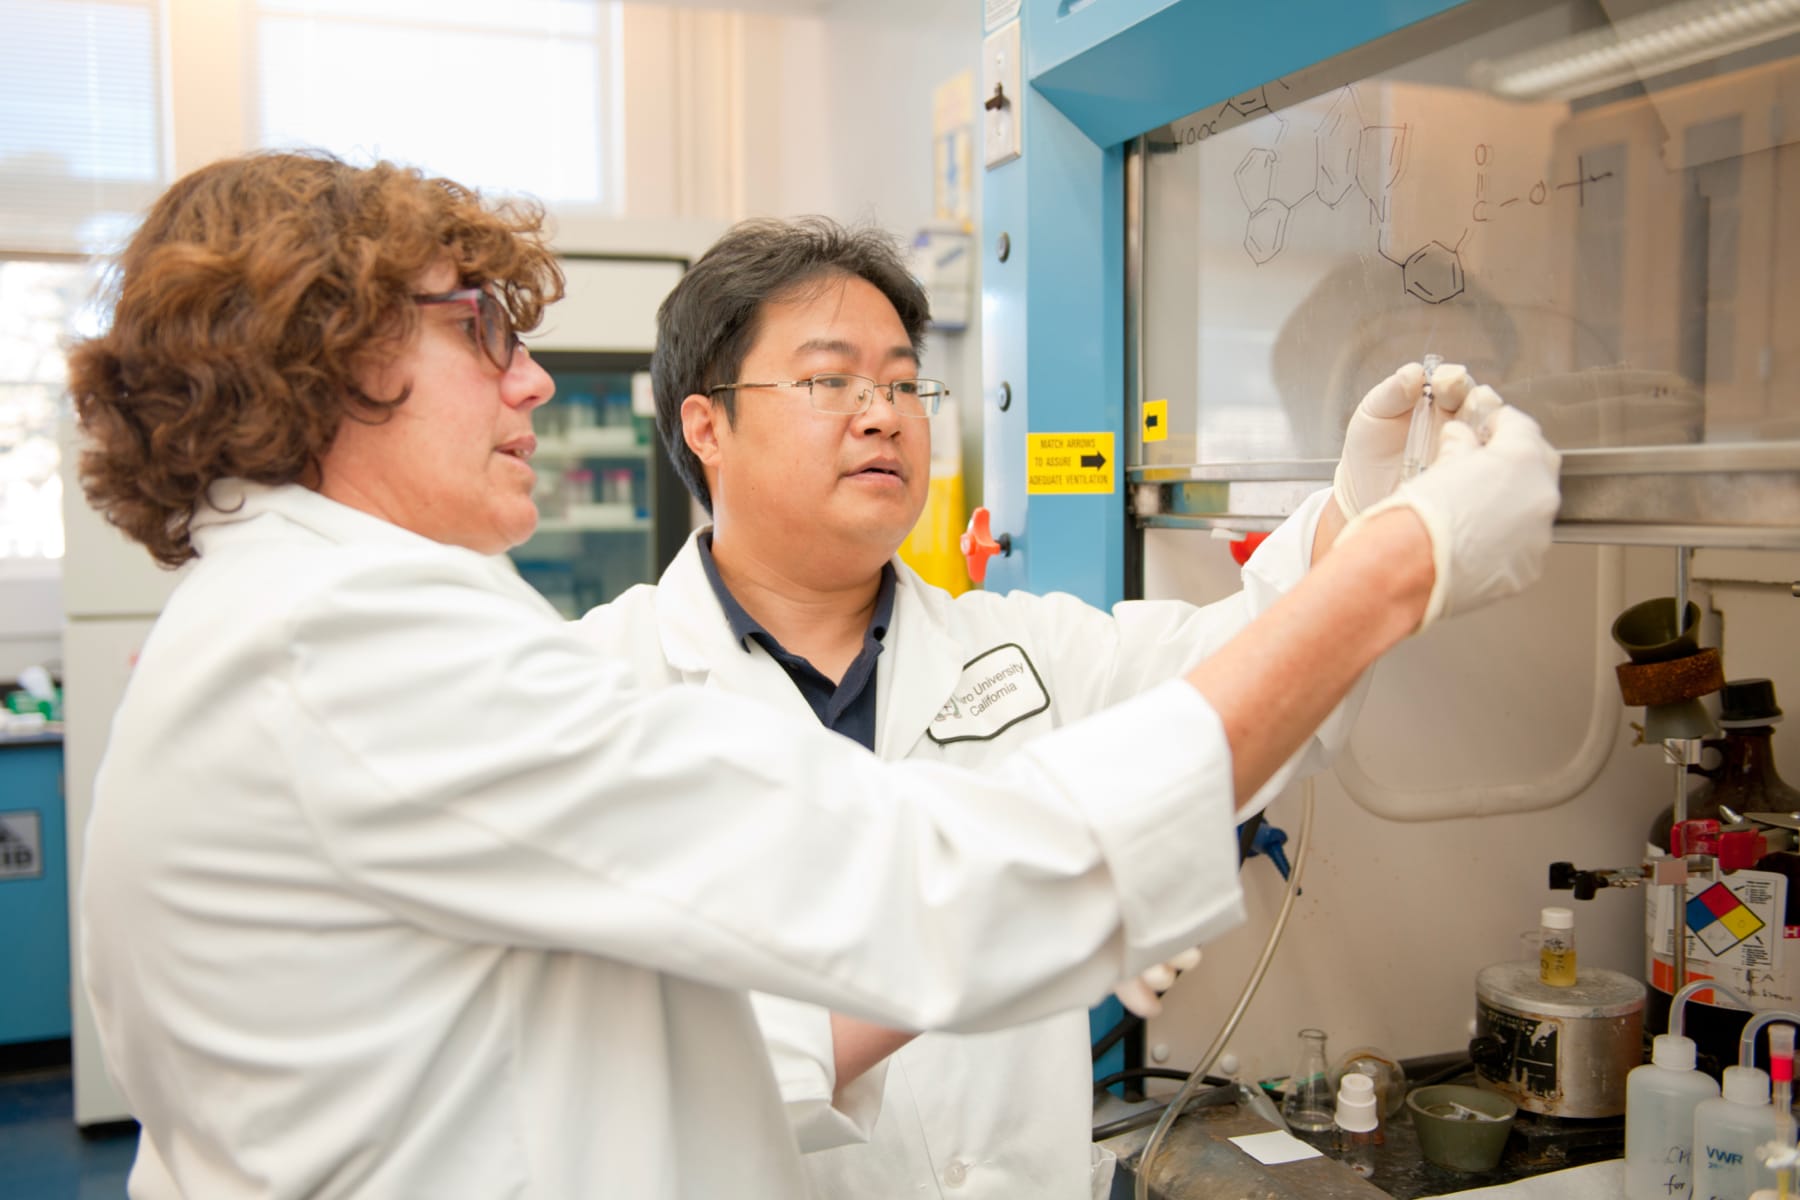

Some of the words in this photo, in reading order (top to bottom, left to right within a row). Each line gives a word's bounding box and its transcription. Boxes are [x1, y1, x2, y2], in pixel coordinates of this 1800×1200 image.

[1040, 439, 1063, 449] MATCH
[1066, 438, 1096, 449] ARROWS
[1034, 457, 1043, 467] TO
[1046, 456, 1072, 466] ASSURE
[1029, 474, 1062, 486] ADEQUATE
[1066, 474, 1108, 485] VENTILATION
[973, 662, 1025, 695] University
[969, 681, 1018, 717] California
[1706, 1145, 1744, 1166] VWR
